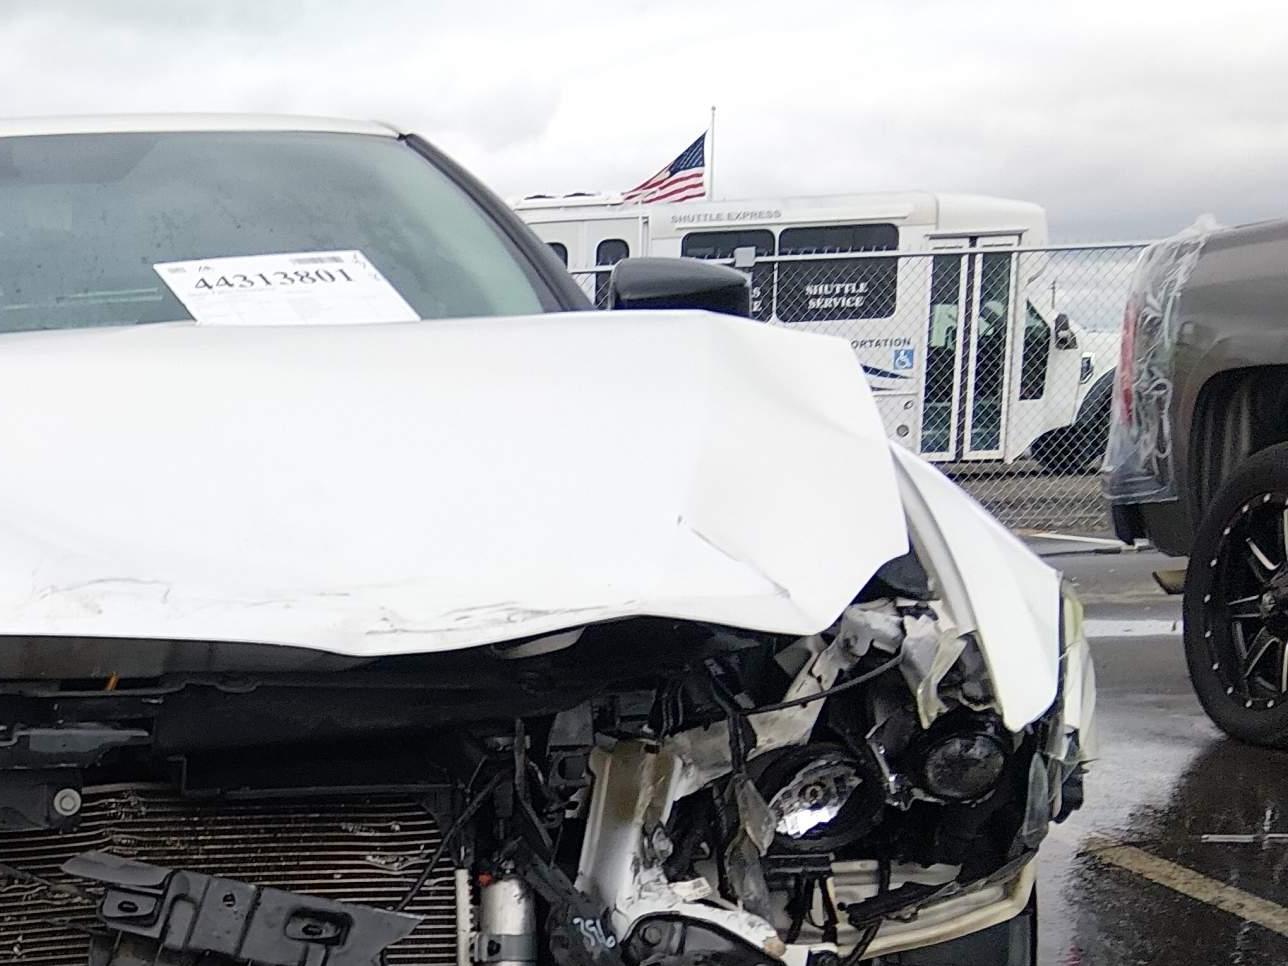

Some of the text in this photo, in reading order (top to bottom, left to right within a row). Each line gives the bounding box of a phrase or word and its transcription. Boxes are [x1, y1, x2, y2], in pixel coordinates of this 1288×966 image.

[671, 210, 782, 223] SHUTTLE EXPRESS
[194, 268, 353, 290] 44313801
[805, 282, 869, 296] SHUTTLE
[808, 296, 864, 310] SERVICE
[850, 338, 912, 350] ORTATION
